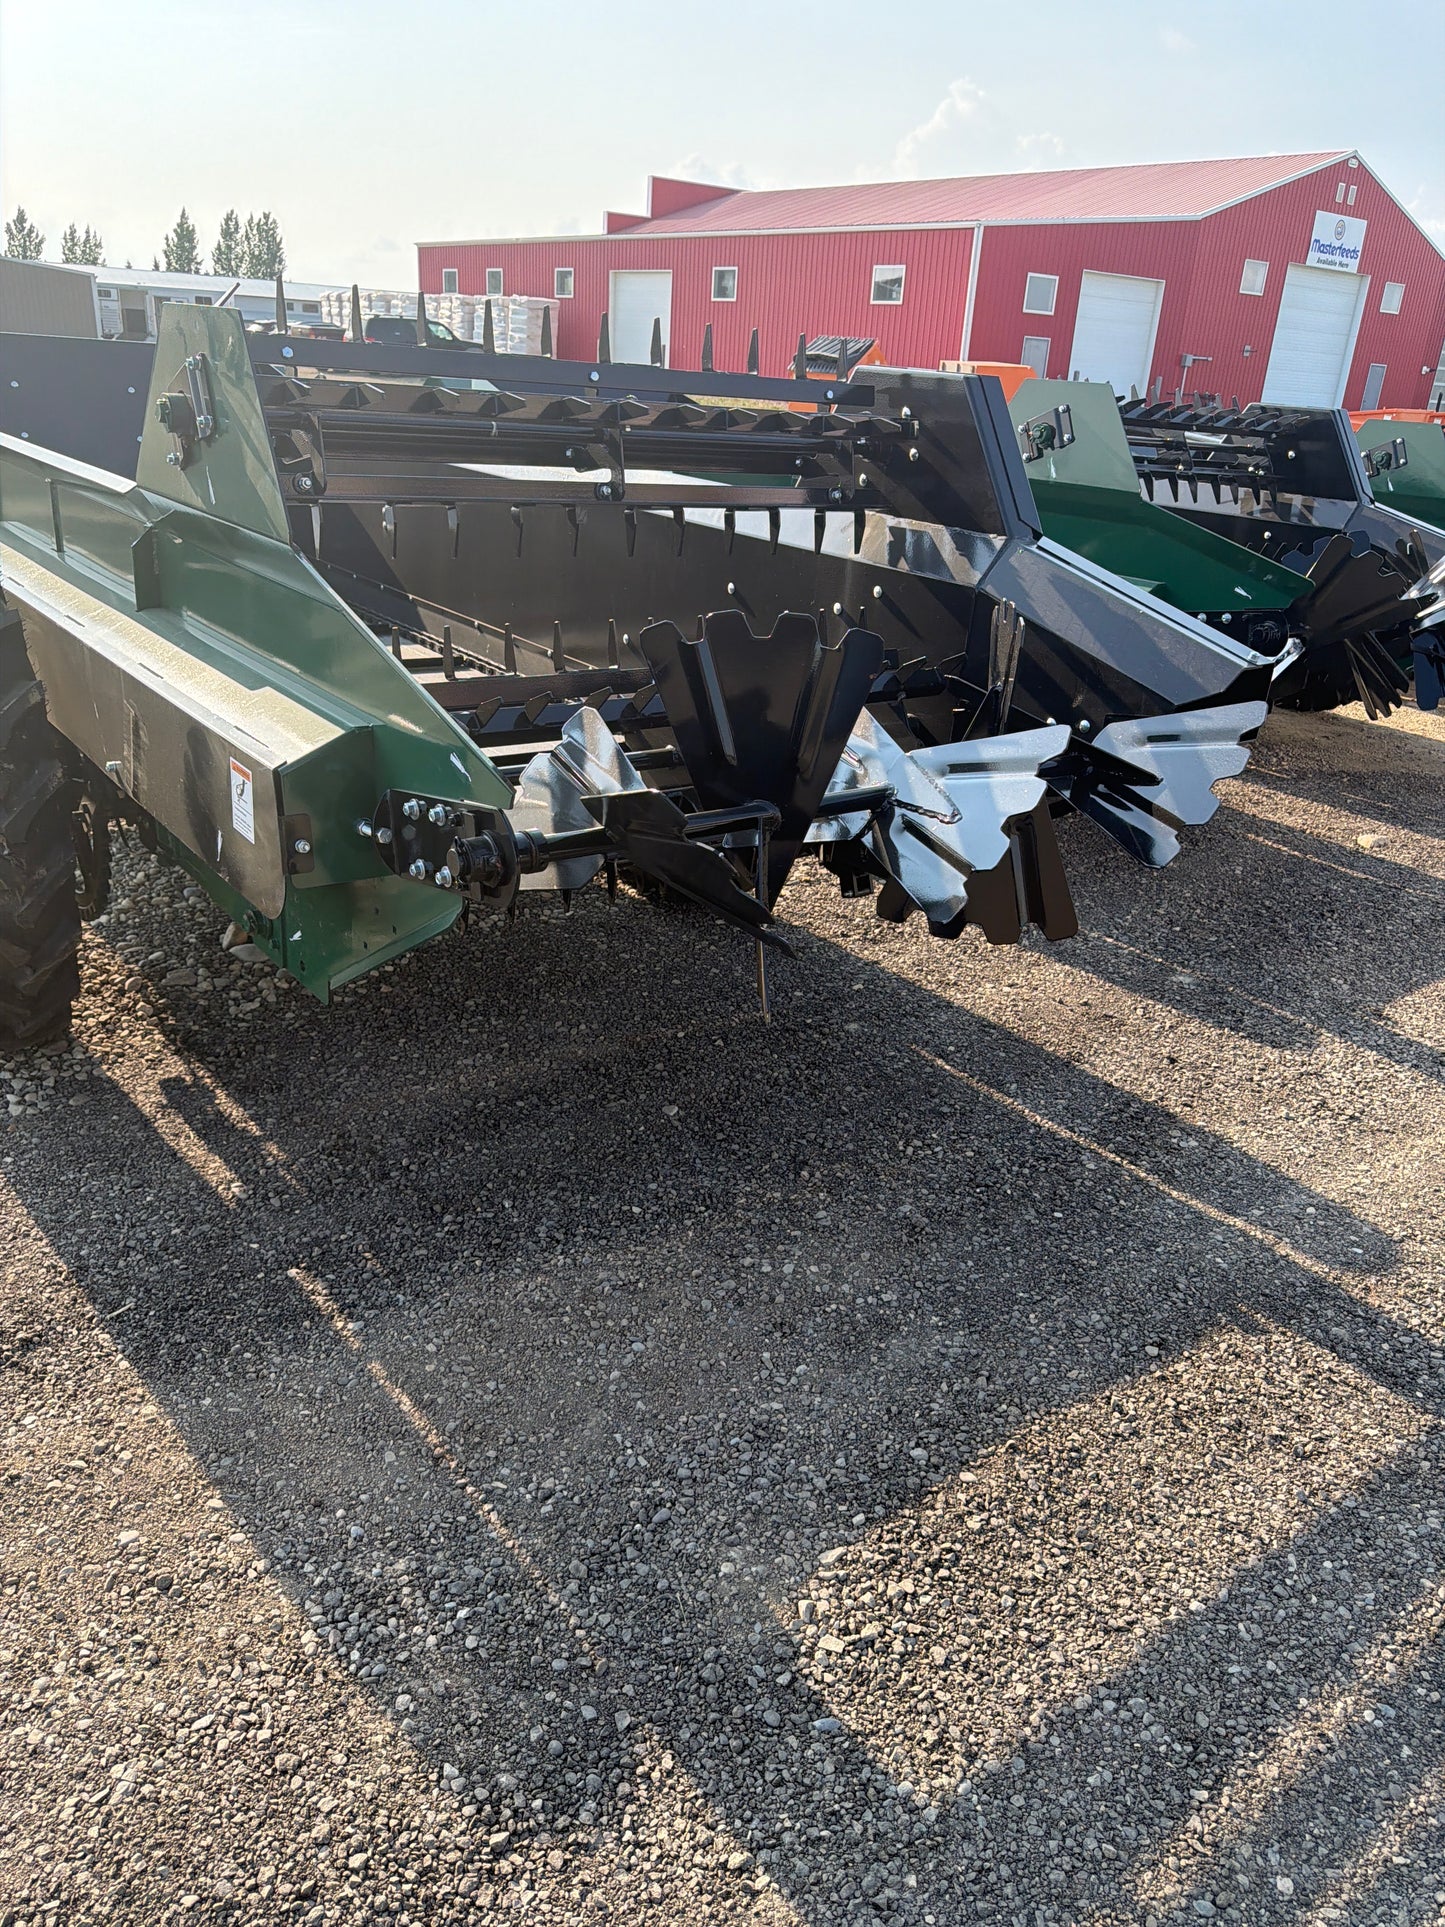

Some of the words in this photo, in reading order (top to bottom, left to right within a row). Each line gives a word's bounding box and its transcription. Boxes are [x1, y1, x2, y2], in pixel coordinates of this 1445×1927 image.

[1311, 238, 1360, 260] Masterfeeds
[1316, 257, 1338, 267] Available
[1338, 260, 1349, 268] Here
